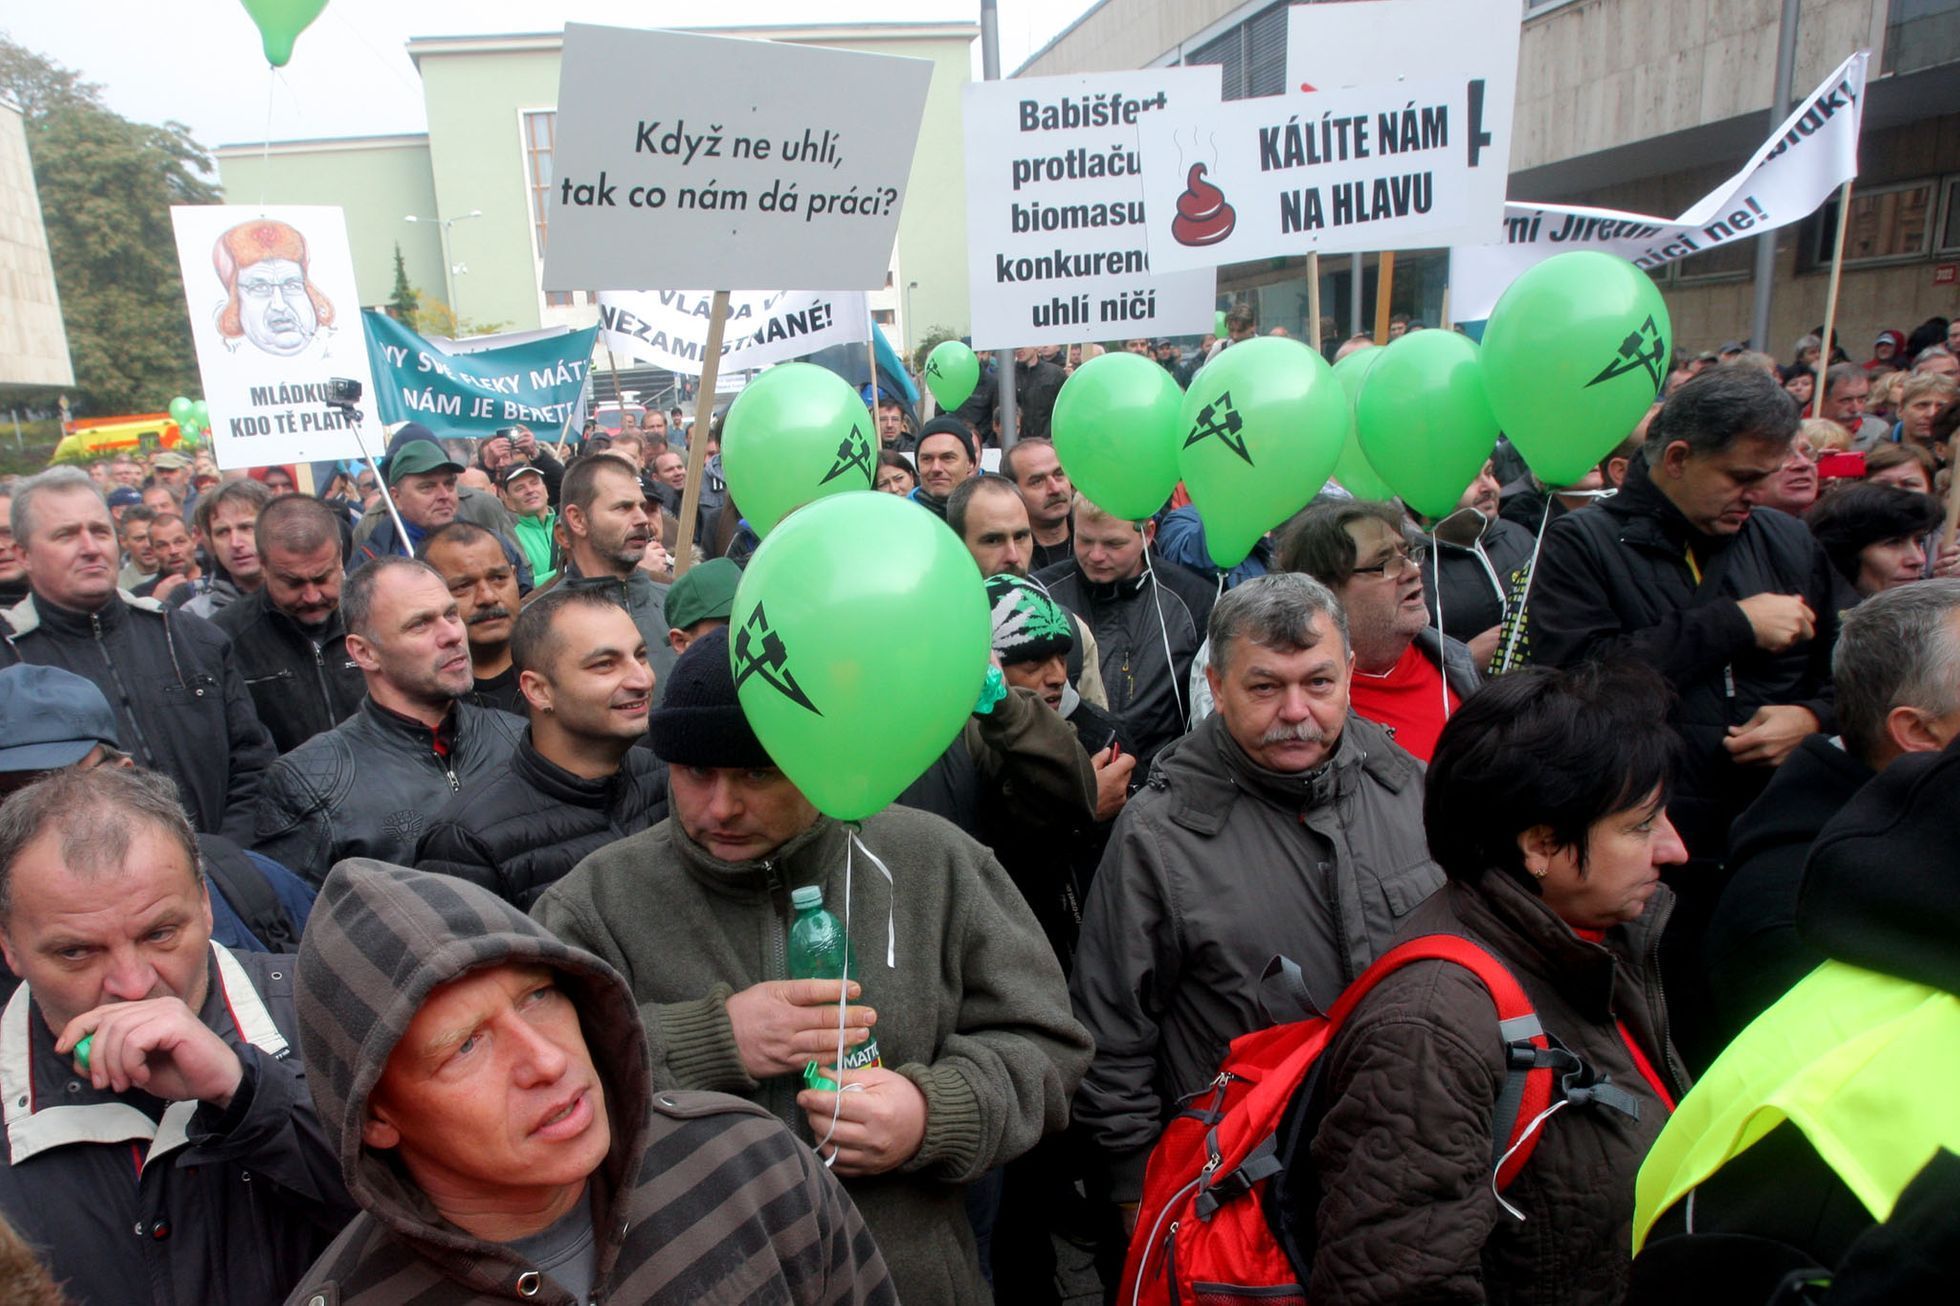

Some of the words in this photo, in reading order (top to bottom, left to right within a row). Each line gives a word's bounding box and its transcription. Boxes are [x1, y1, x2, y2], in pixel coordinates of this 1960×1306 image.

[635, 120, 723, 165] Když
[732, 137, 771, 160] ne
[781, 128, 843, 169] uhlí,
[1258, 110, 1371, 173] KÁLÍTE
[1377, 100, 1449, 156] NÁM
[561, 171, 617, 207] tak
[628, 185, 667, 209] co
[677, 179, 748, 211] nám
[758, 179, 798, 213] dá
[806, 186, 898, 222] práci?
[1011, 200, 1146, 234] biomasu
[1280, 186, 1325, 235] NA
[1331, 171, 1433, 227] HLAVU
[1703, 195, 1769, 243] ne!
[1032, 293, 1090, 328] uhlí
[1100, 288, 1156, 323] ničí
[529, 359, 588, 391] MÁT
[229, 415, 272, 438] KDO
[273, 409, 298, 434] TĚ
[402, 386, 462, 417] NÁM
[470, 397, 495, 419] JE
